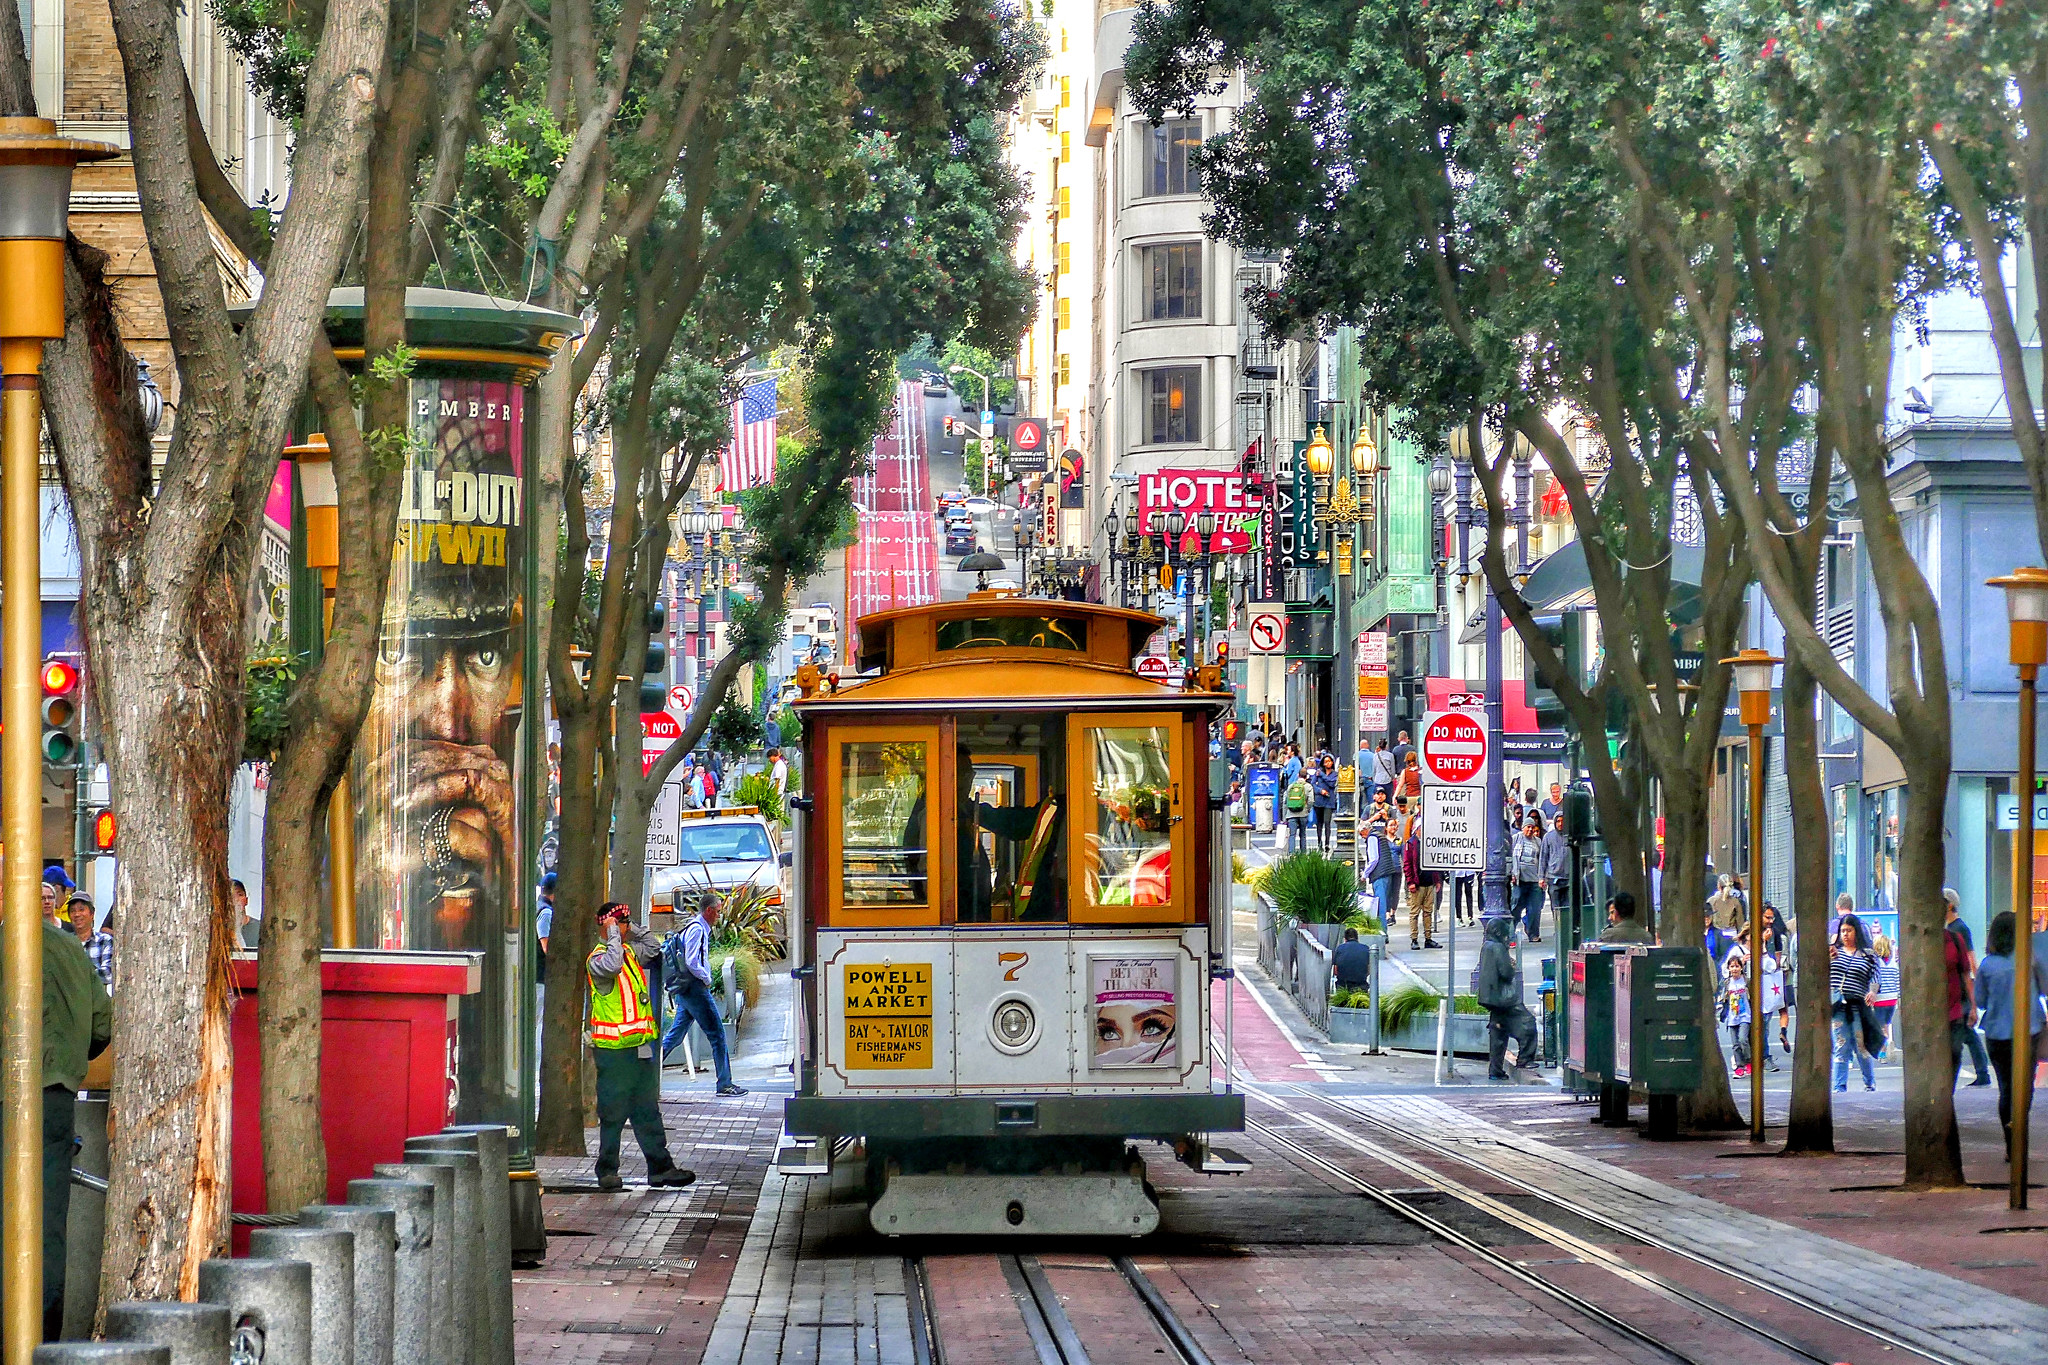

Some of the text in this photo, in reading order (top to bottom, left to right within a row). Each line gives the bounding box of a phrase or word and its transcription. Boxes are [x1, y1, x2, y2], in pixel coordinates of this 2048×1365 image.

[417, 399, 511, 421] EMBER
[399, 469, 523, 527] LL OF DUTY
[1146, 476, 1262, 508] HOTEL
[1046, 495, 1056, 535] PARK
[1145, 511, 1257, 533] SAFOR
[1264, 502, 1274, 598] COCKTAILS
[652, 722, 676, 735] NOT
[1433, 726, 1478, 739] DO NOT
[1436, 757, 1473, 770] ENTER
[1436, 790, 1472, 802] EXCEPT
[1442, 806, 1466, 817] MUNI
[649, 818, 663, 829] XIS
[1440, 821, 1468, 833] TAXIS
[646, 833, 676, 846] ERCIAL
[1425, 837, 1481, 849] COMMERCIAL
[646, 849, 671, 861] CLES
[1430, 852, 1476, 865] VEHICLES
[997, 951, 1029, 982] 7
[1110, 967, 1158, 979] BETER
[849, 971, 927, 984] POWELL
[869, 985, 908, 995] AND
[847, 995, 928, 1008] MARKET
[849, 1023, 929, 1039] BAY AND TAYLOR
[856, 1041, 922, 1052] FISHERMANS
[872, 1052, 906, 1063] WHARF
